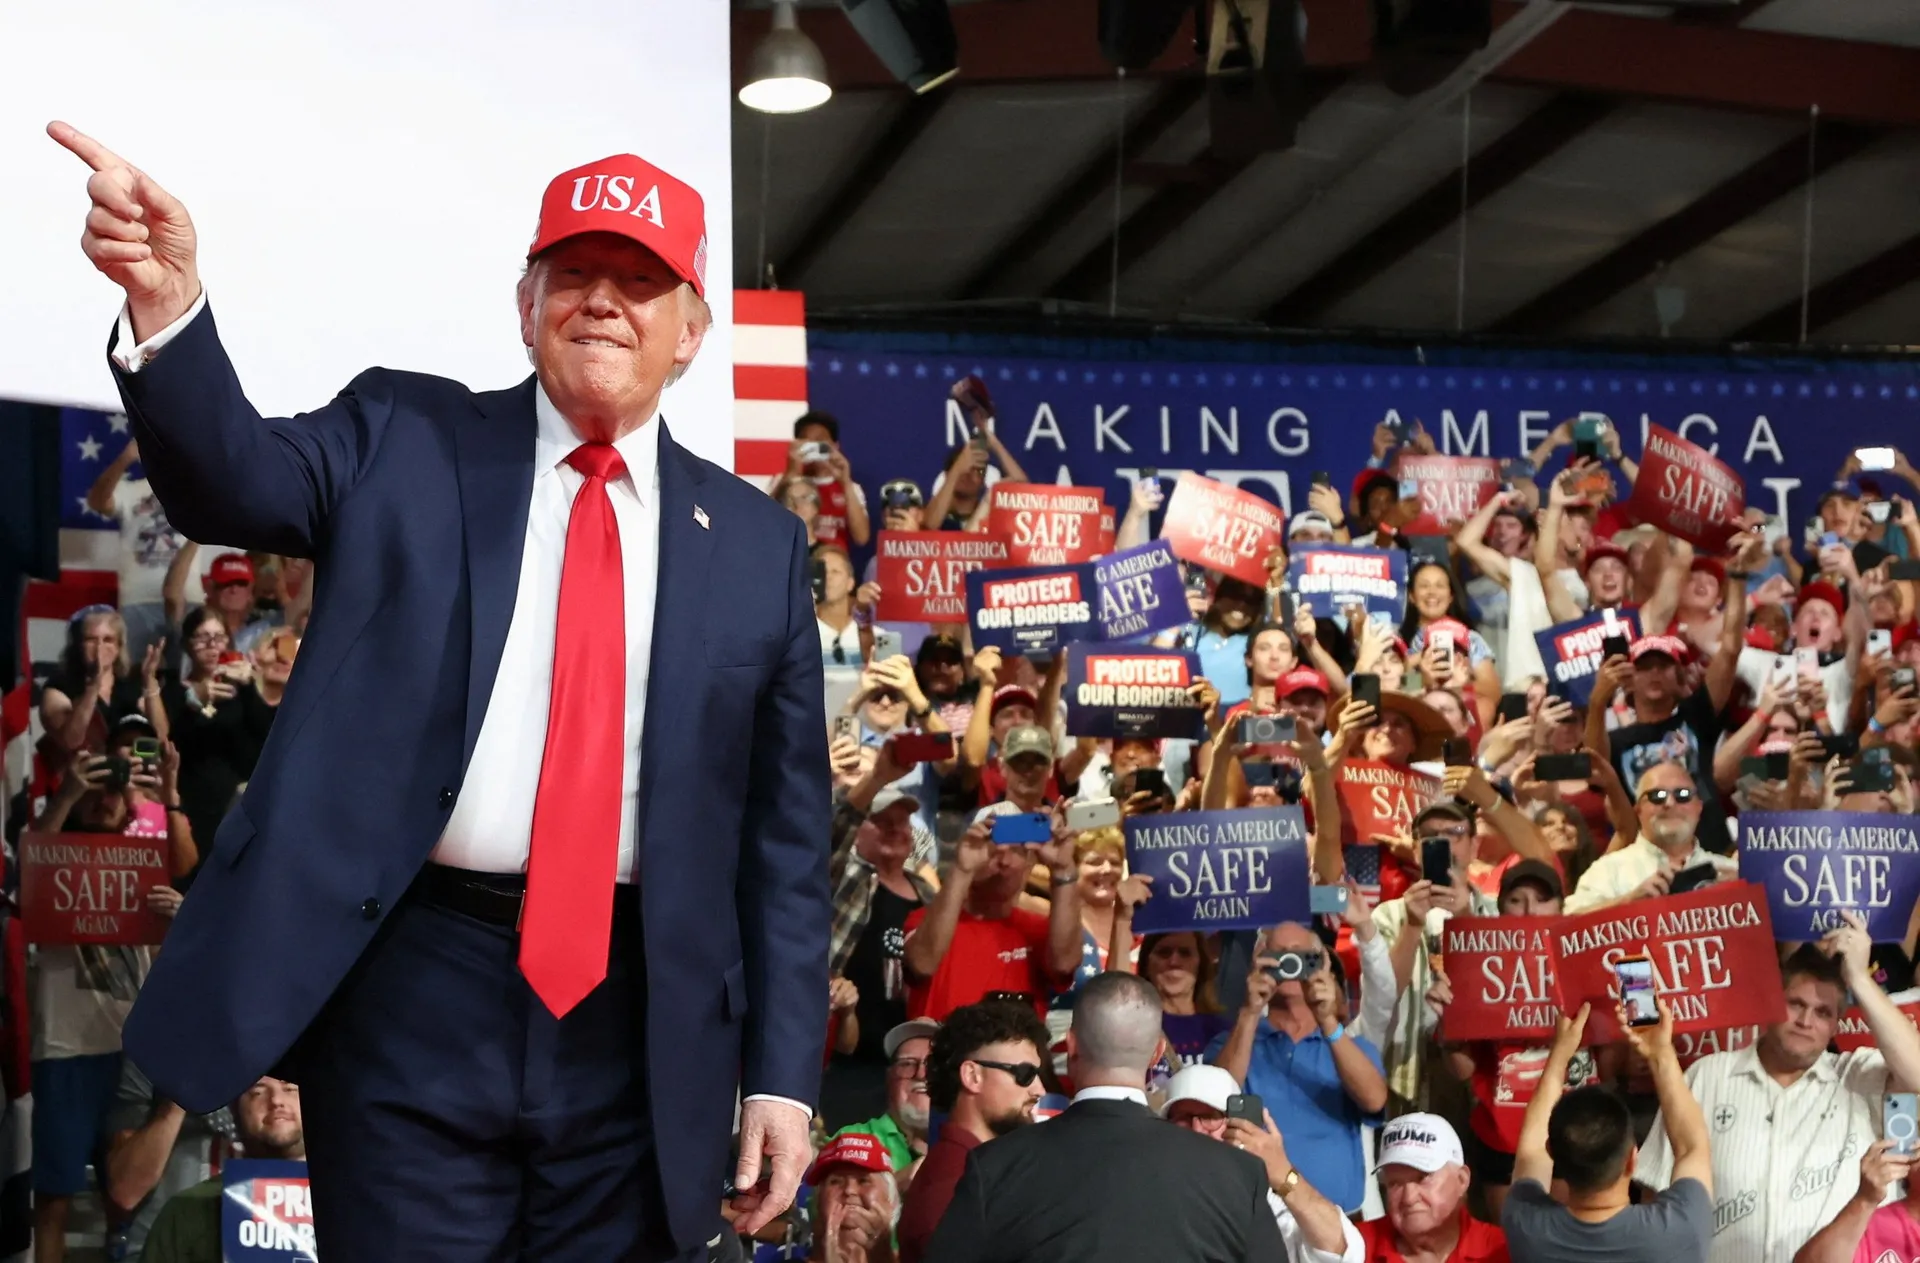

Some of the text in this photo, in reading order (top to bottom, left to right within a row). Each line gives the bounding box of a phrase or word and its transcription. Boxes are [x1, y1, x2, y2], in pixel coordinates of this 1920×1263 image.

[570, 175, 665, 229] USA
[946, 398, 1785, 464] MAKING MEICA
[1650, 434, 1699, 472] MAKING
[995, 491, 1100, 514] MAKING AMERICA
[1421, 479, 1480, 514] SAFE
[1658, 464, 1729, 526] SAFE
[1013, 511, 1083, 550] SAFE
[1236, 500, 1282, 533] AMERICA
[1192, 506, 1264, 559] SAFE
[883, 540, 1008, 560] MAKING AMERICA
[1027, 547, 1068, 565] AGAIN
[1109, 548, 1173, 582] AMERICA
[1311, 553, 1385, 577] PROTECT
[905, 559, 984, 598] SAF
[990, 575, 1073, 608] PROTECT
[1298, 573, 1331, 594] OUR
[1331, 572, 1397, 600] BORDERS
[1098, 572, 1160, 623] AFE
[977, 600, 1091, 630] OUR BORDERS
[1106, 612, 1149, 639] AGAIN
[1561, 620, 1632, 658] PROT
[1093, 658, 1181, 684] PROTECT
[1554, 654, 1592, 682] OUR
[1077, 683, 1197, 708] OUR BORDERS
[1343, 765, 1405, 788] MAKING
[1134, 819, 1301, 850] MAKING AMERICA
[1746, 826, 1919, 853] MAKING AMERICA
[27, 844, 163, 868] MAKING AMERICA
[1168, 846, 1272, 898] SAFE
[1783, 854, 1892, 908] SAFE
[53, 868, 140, 912] SAFE
[1193, 896, 1250, 920] AGAIN
[1809, 909, 1870, 932] AGIN
[73, 915, 120, 934] AGAIN
[1559, 914, 1650, 959] MAKING
[1655, 901, 1762, 938] AMERICA
[1450, 929, 1526, 953] MAKING
[1383, 1128, 1437, 1146] TRUMP
[842, 1149, 869, 1161] AGAIN
[239, 1219, 294, 1251] OUR
